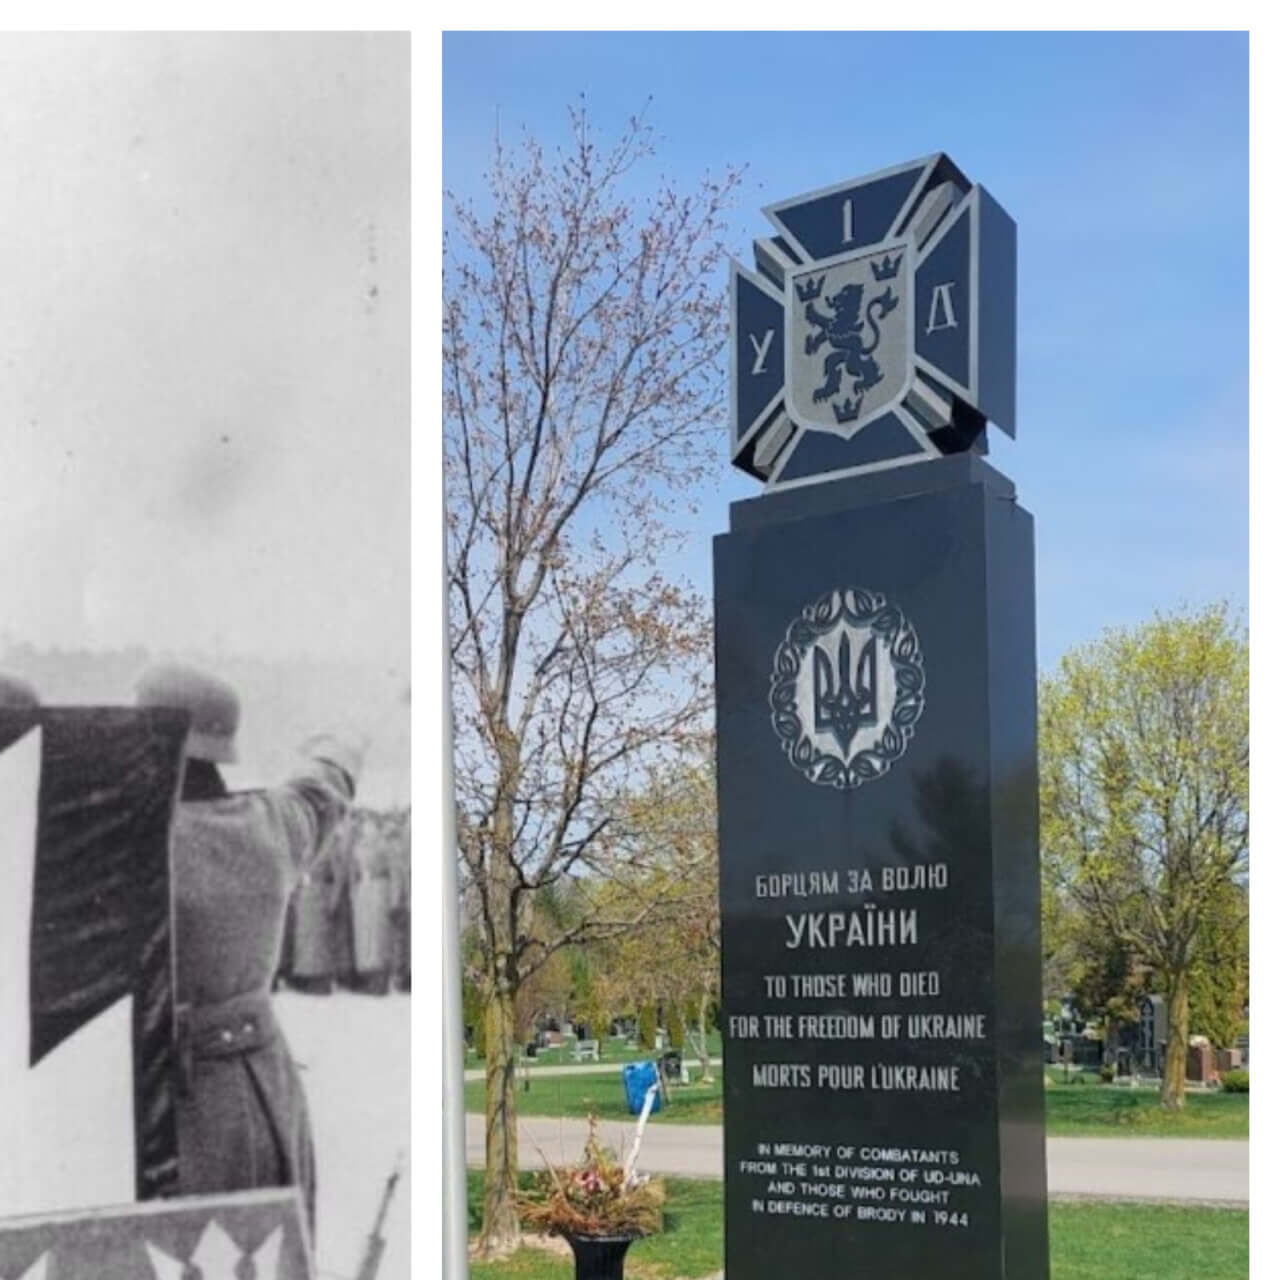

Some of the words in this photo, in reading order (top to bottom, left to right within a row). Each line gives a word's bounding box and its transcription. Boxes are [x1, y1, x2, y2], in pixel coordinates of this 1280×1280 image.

[756, 870, 839, 898] БОРЦЯМ
[847, 869, 873, 893] ЗА
[882, 864, 949, 892] ВОЛЮ
[785, 903, 918, 949] УКРАЇНИ
[764, 975, 786, 999] TO
[791, 973, 846, 999] THOSE
[851, 972, 892, 998] WHO
[899, 971, 940, 997] DIED
[729, 1015, 759, 1039] FOR
[764, 1015, 793, 1039] THE
[798, 1015, 875, 1039] FREEDOM
[881, 1015, 901, 1039] OF
[908, 1014, 987, 1040] UKRAINE
[752, 1063, 811, 1089] MORTS
[818, 1065, 865, 1090] POUR
[758, 1143, 771, 1156] IN
[774, 1144, 832, 1160] MEMORY
[837, 1147, 855, 1160] OF
[859, 1147, 960, 1165] COMBATANTS
[740, 1161, 777, 1176] FROM
[782, 1163, 807, 1177] THE
[812, 1164, 831, 1178] 1st
[834, 1165, 894, 1182] DIVISION
[899, 1169, 919, 1183] OF
[767, 1181, 796, 1195] AND
[801, 1183, 846, 1199] THOSE
[850, 1185, 886, 1200] WHO
[889, 1187, 950, 1205] FOUGHT
[752, 1199, 765, 1212] IN
[767, 1200, 830, 1217] DEFENCE
[833, 1204, 853, 1218] OF
[856, 1205, 906, 1223] BRODY
[911, 1210, 926, 1223] IN
[933, 1210, 969, 1227] 1944
